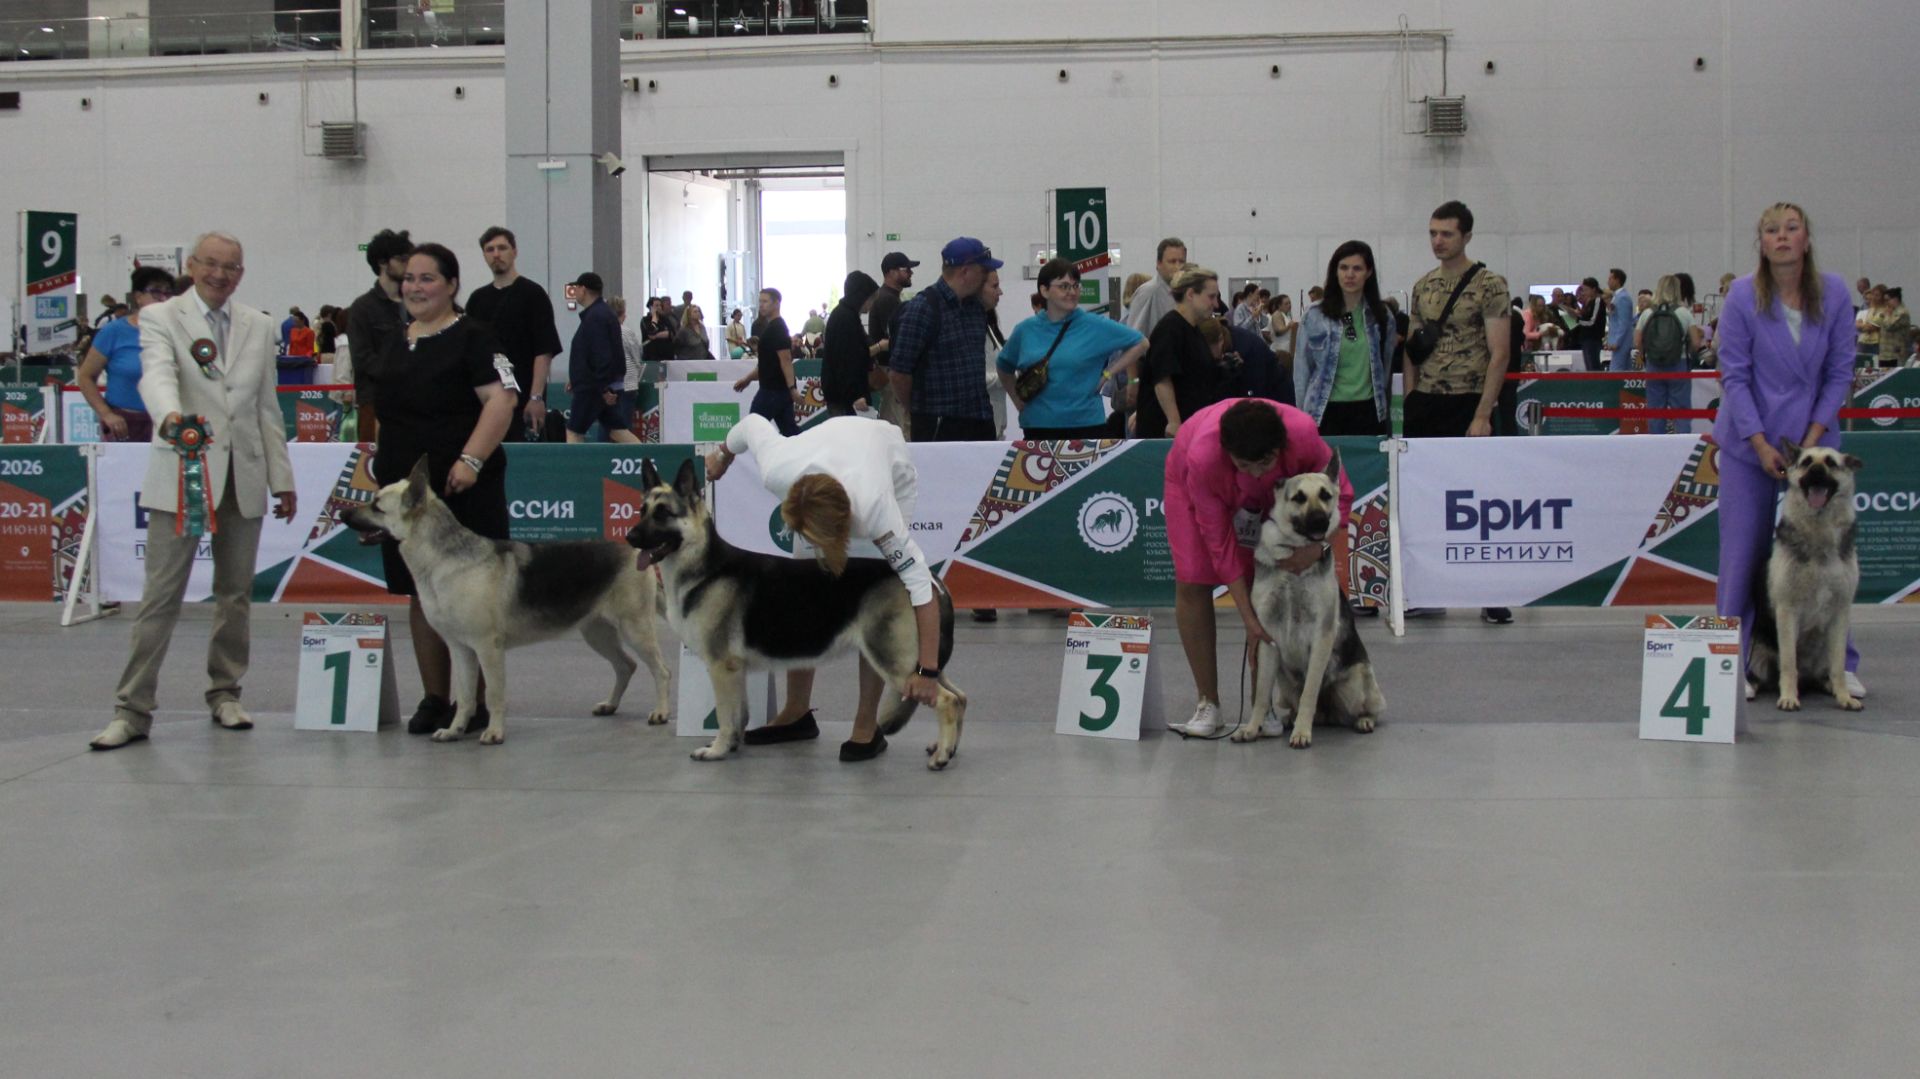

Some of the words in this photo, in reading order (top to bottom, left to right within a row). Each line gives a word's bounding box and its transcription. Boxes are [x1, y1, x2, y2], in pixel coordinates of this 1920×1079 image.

[1063, 210, 1101, 250] 10
[41, 230, 62, 268] 9
[5, 391, 27, 400] 2026
[300, 390, 323, 399] 2026
[5, 413, 29, 422] 20-21
[299, 412, 324, 421] 20-21
[1, 460, 43, 475] 2026
[1855, 492, 1920, 511] ОССИ
[0, 503, 46, 518] 20-21
[509, 500, 575, 519] ССИЯ
[609, 503, 640, 519] 20-
[1446, 490, 1573, 540] Брит
[2, 525, 47, 535] ИЮНЯ
[1446, 545, 1573, 560] ПРЕМИУМ
[303, 636, 327, 646] Брит
[1066, 638, 1090, 649] Брит
[1646, 641, 1674, 652] Брит
[324, 651, 351, 725] 1
[1079, 654, 1123, 732] 3
[1659, 657, 1711, 735] 4
